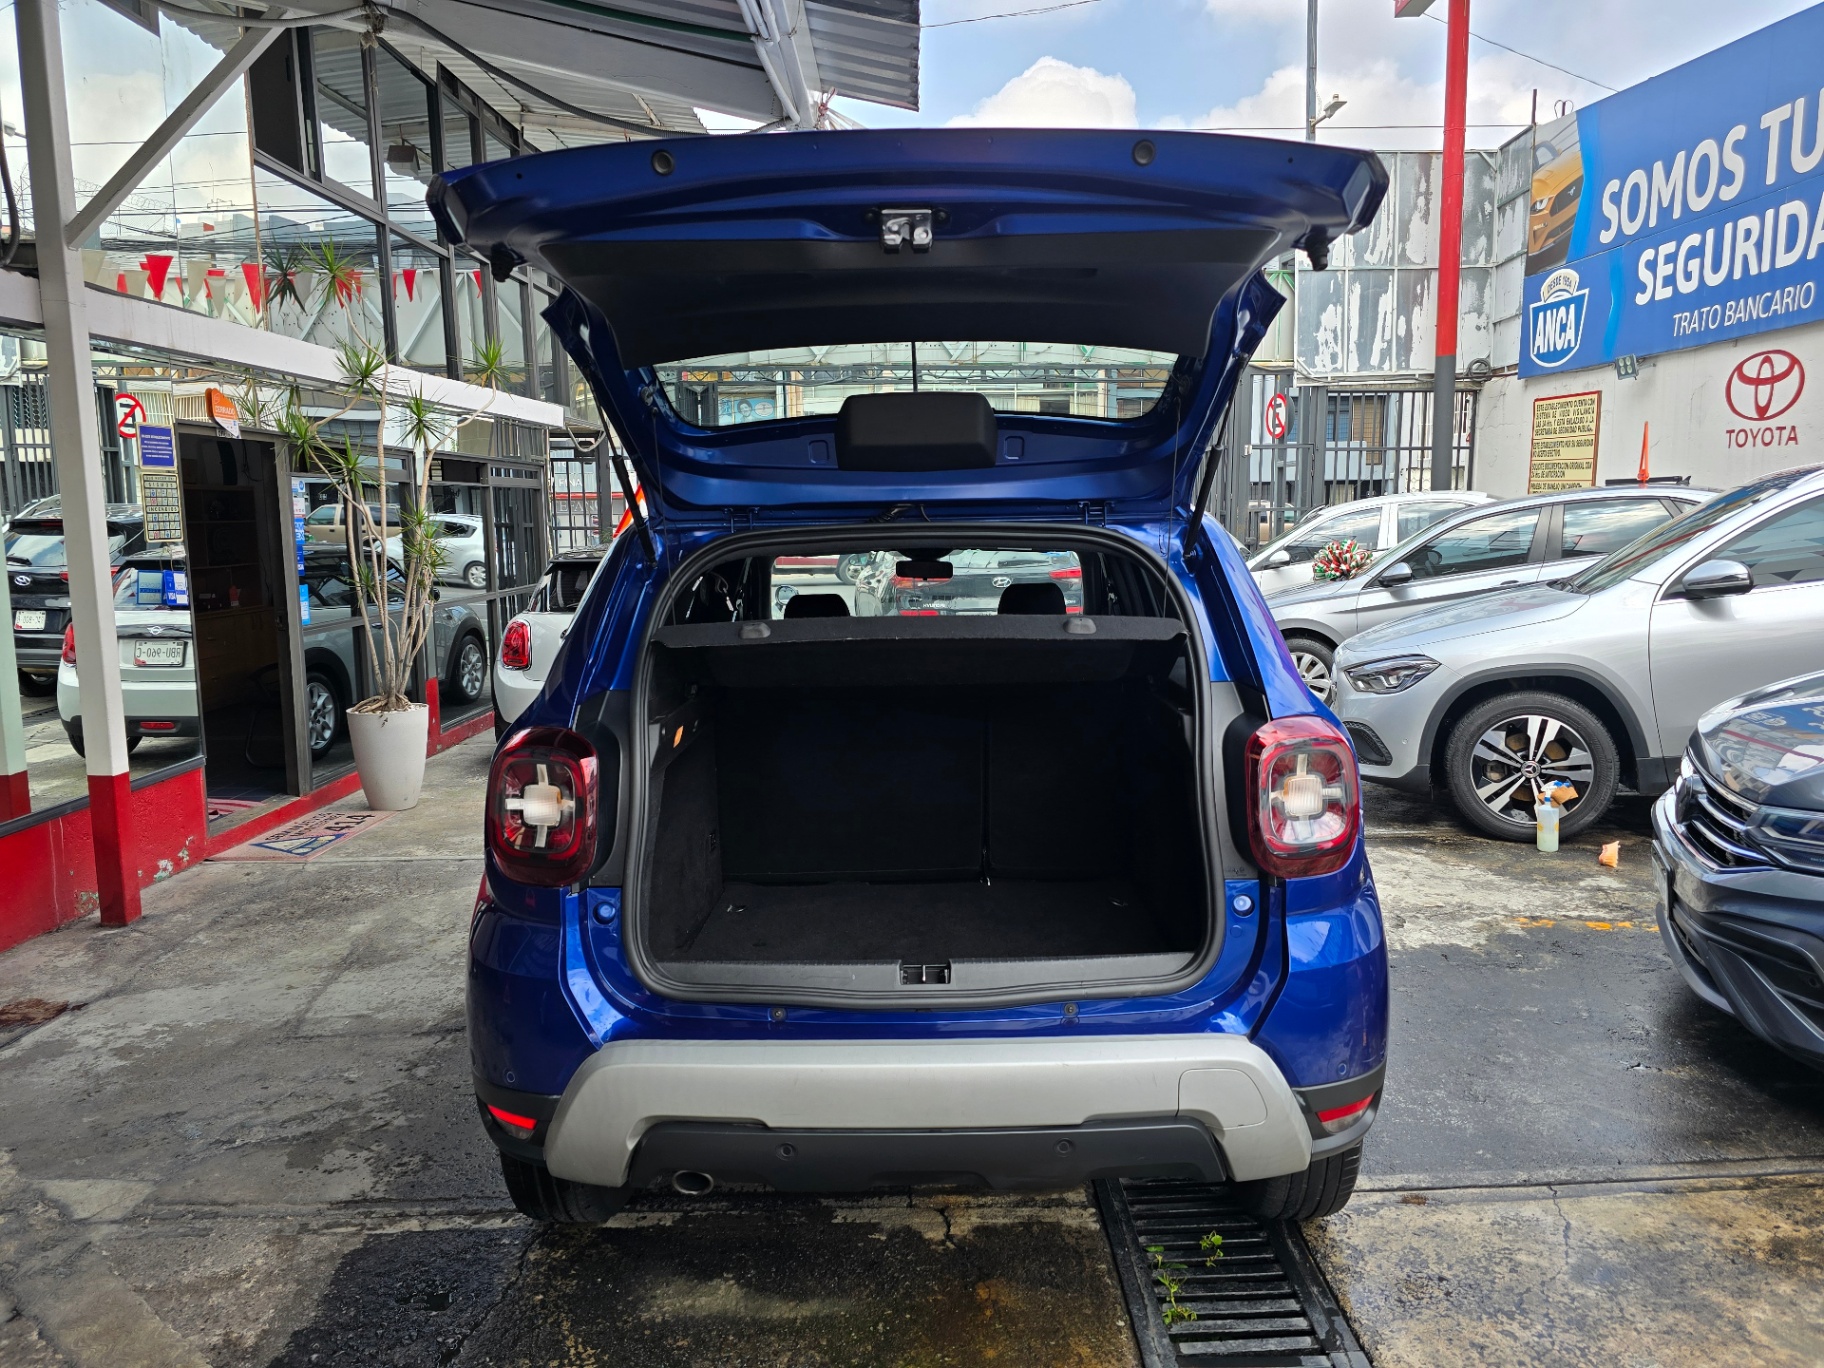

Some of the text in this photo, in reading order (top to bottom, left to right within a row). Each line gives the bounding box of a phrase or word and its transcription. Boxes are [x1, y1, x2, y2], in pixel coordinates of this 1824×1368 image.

[1600, 124, 1746, 244] SOMOS
[1547, 275, 1562, 293] DESDE
[1673, 281, 1816, 337] TRATO BANCARIO
[1533, 303, 1575, 355] ANCA
[215, 405, 235, 415] CERRADO
[1726, 425, 1799, 449] TOYOTA
[324, 814, 375, 832] 414
